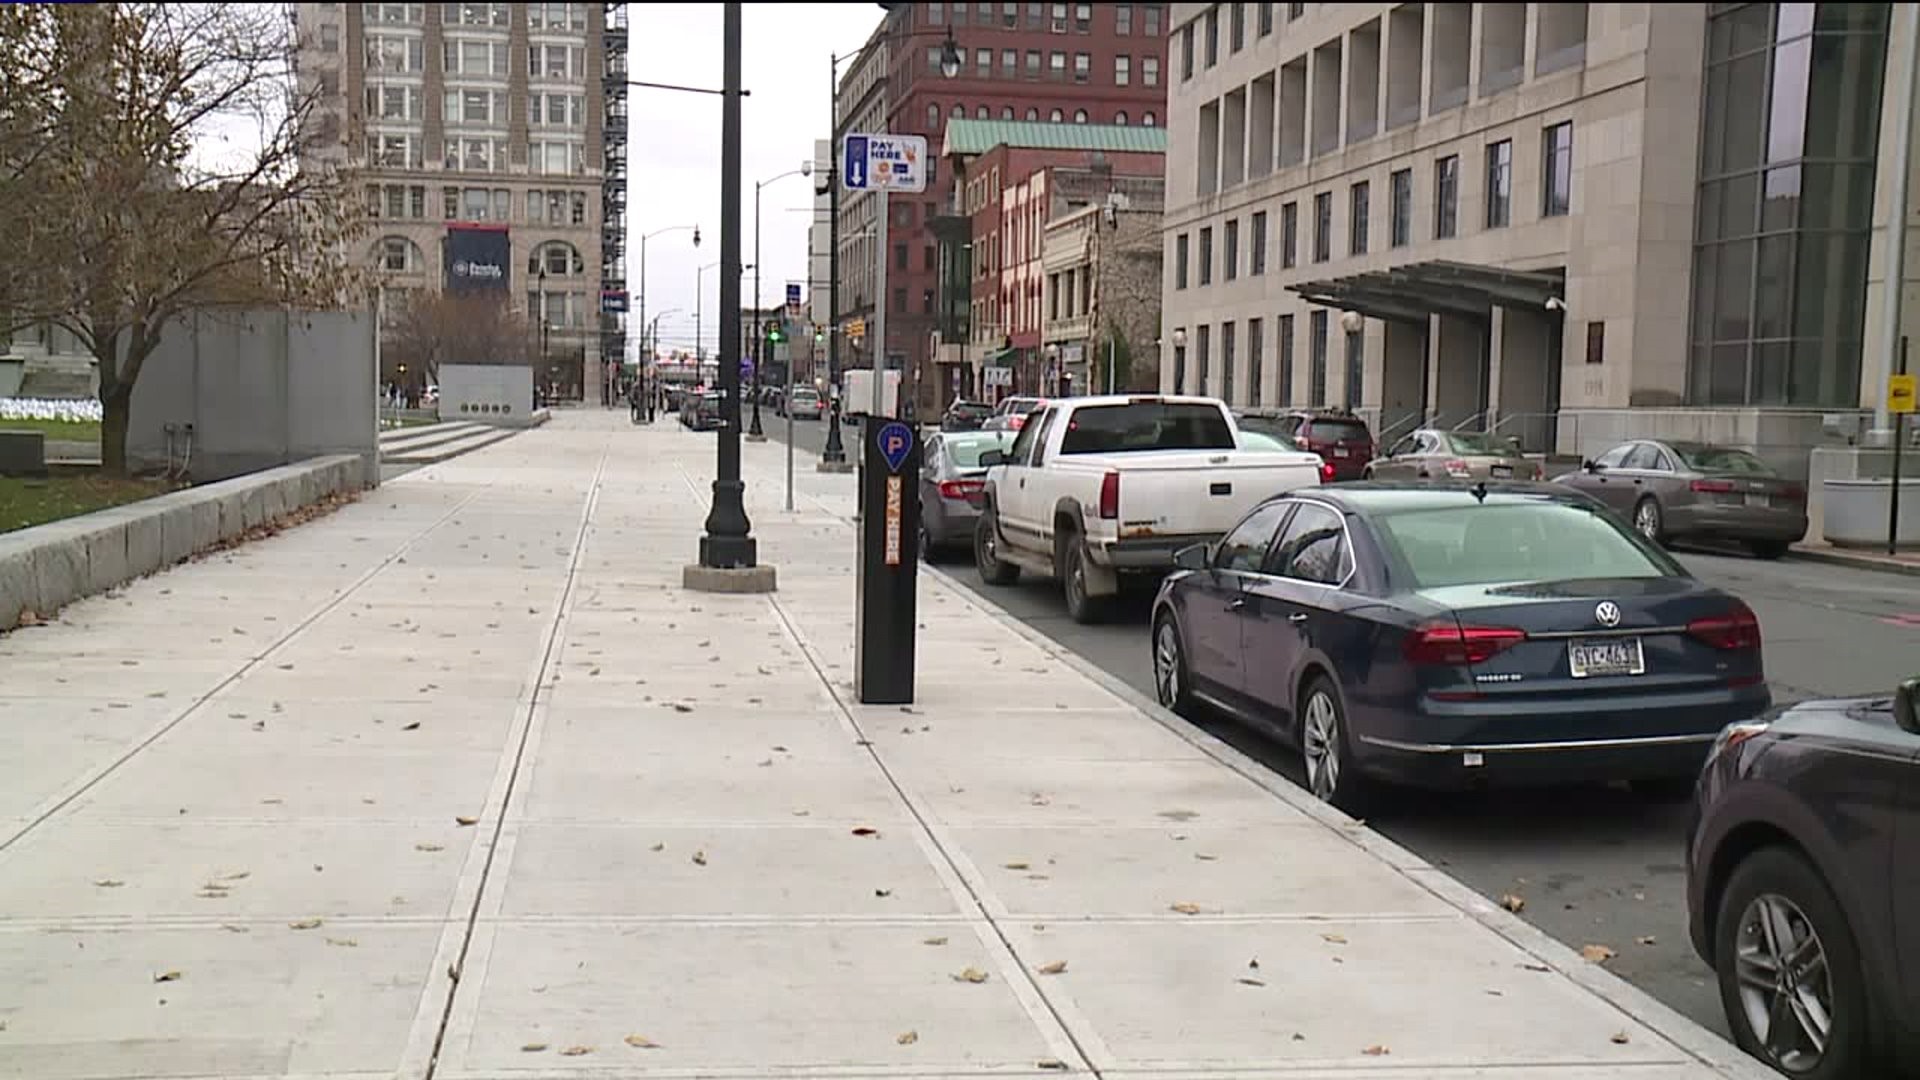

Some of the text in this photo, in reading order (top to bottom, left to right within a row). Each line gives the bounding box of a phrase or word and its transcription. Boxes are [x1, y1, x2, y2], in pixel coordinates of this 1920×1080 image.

[871, 141, 894, 150] PAY
[871, 150, 901, 160] HERE
[887, 436, 904, 455] P
[885, 476, 902, 565] PAY HERE
